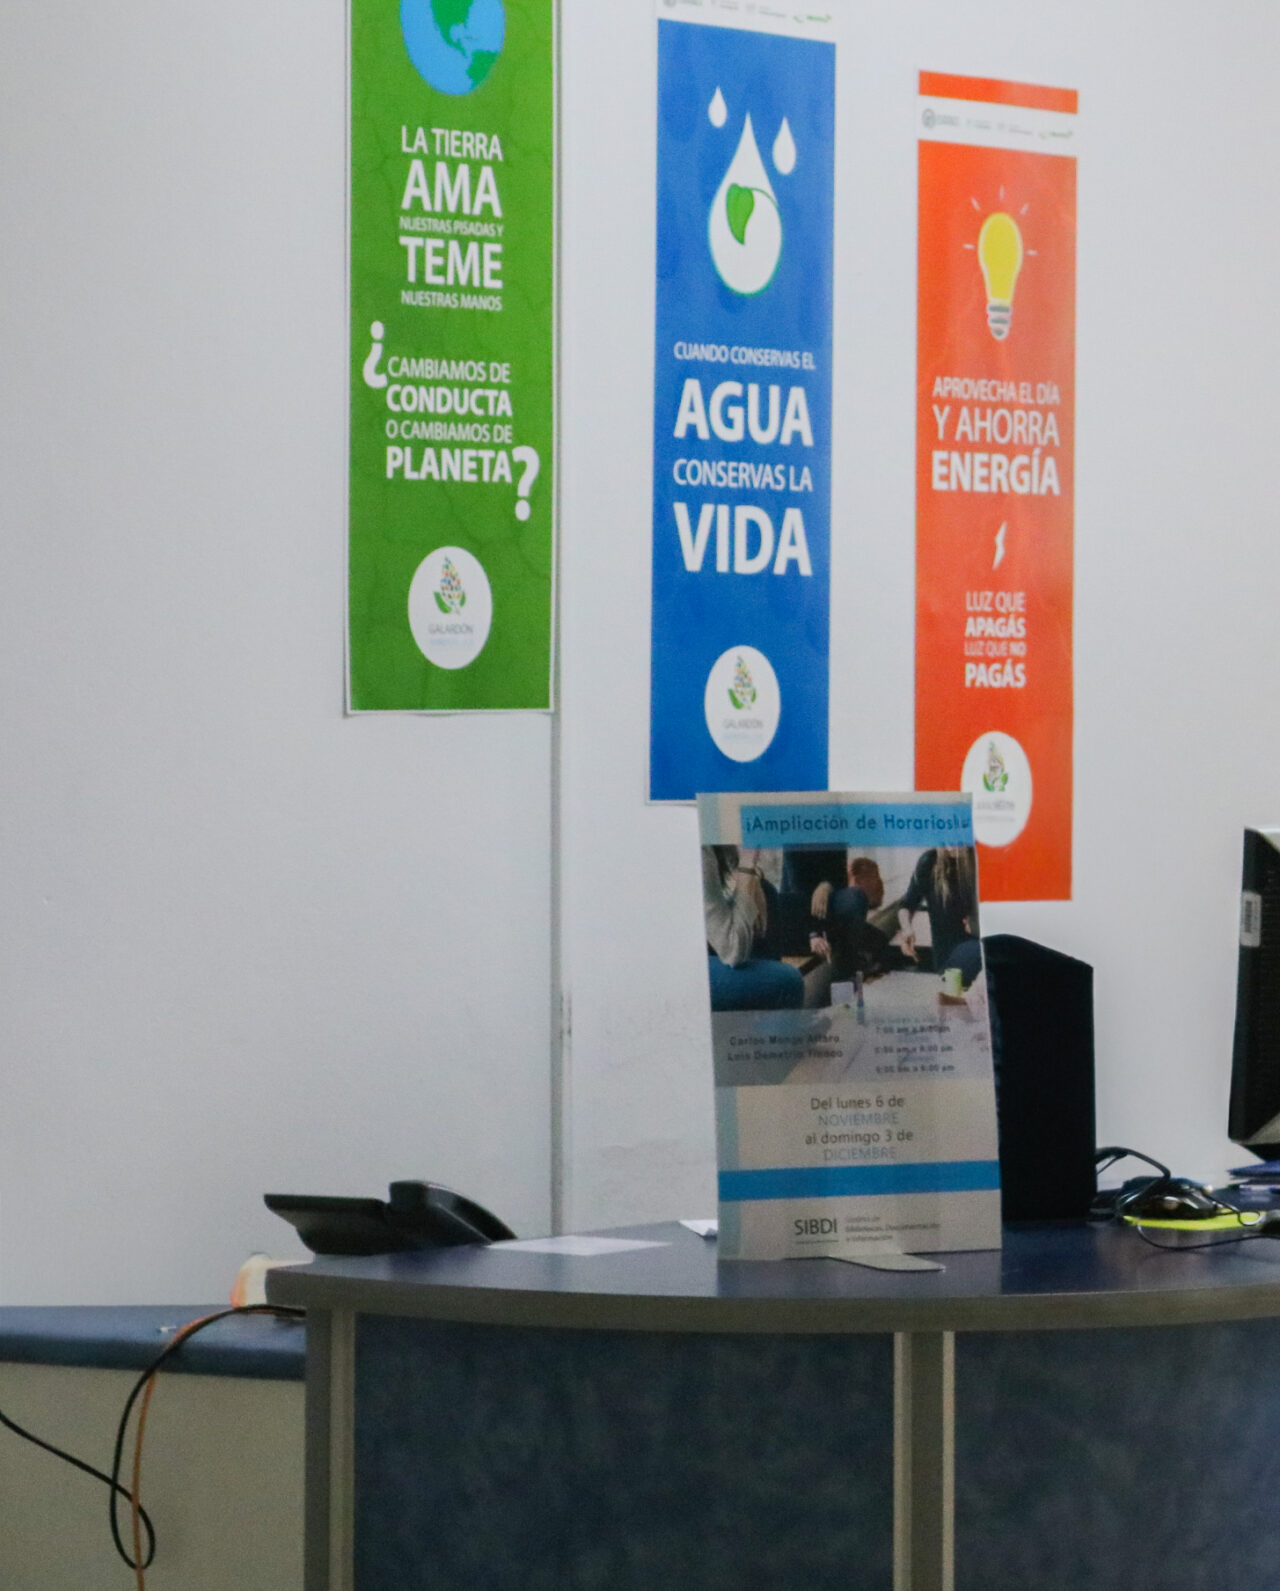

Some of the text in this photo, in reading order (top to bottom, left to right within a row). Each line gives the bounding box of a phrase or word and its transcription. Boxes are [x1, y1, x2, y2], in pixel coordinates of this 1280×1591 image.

[401, 125, 504, 161] LA TIERRA
[401, 159, 503, 218] AMA
[400, 216, 504, 237] NUESTRAS PISADAS Y
[399, 236, 504, 289] TEME
[401, 290, 503, 312] NUESTRAS MANOS
[673, 341, 816, 370] CUANDO CONSERVAS EL
[489, 362, 512, 384] DE
[386, 384, 513, 418] CONDUCTA
[932, 376, 1017, 403] APROVECHA
[1019, 382, 1035, 404] EL
[673, 378, 815, 448] AGUA
[932, 404, 1061, 447] Y AHORRA
[385, 419, 513, 444] O CAMBIAMOS DE
[673, 458, 814, 492] CONSERVAS LA
[931, 448, 1062, 496] ENERGÍA
[672, 501, 814, 577] VIDA
[965, 591, 1026, 613] LUZ QUE
[964, 613, 1027, 638] APAGÁS
[964, 640, 1027, 657] LUZ QUE NO
[964, 658, 1027, 688] PAGÁS
[855, 814, 876, 830] de
[810, 1095, 905, 1110] Del lunes 6 de
[818, 1112, 900, 1126] NOVIEMBRE
[805, 1129, 914, 1146] al domingo 3 de
[823, 1146, 897, 1161] DICIEMBRE
[794, 1218, 838, 1236] SIBDI
